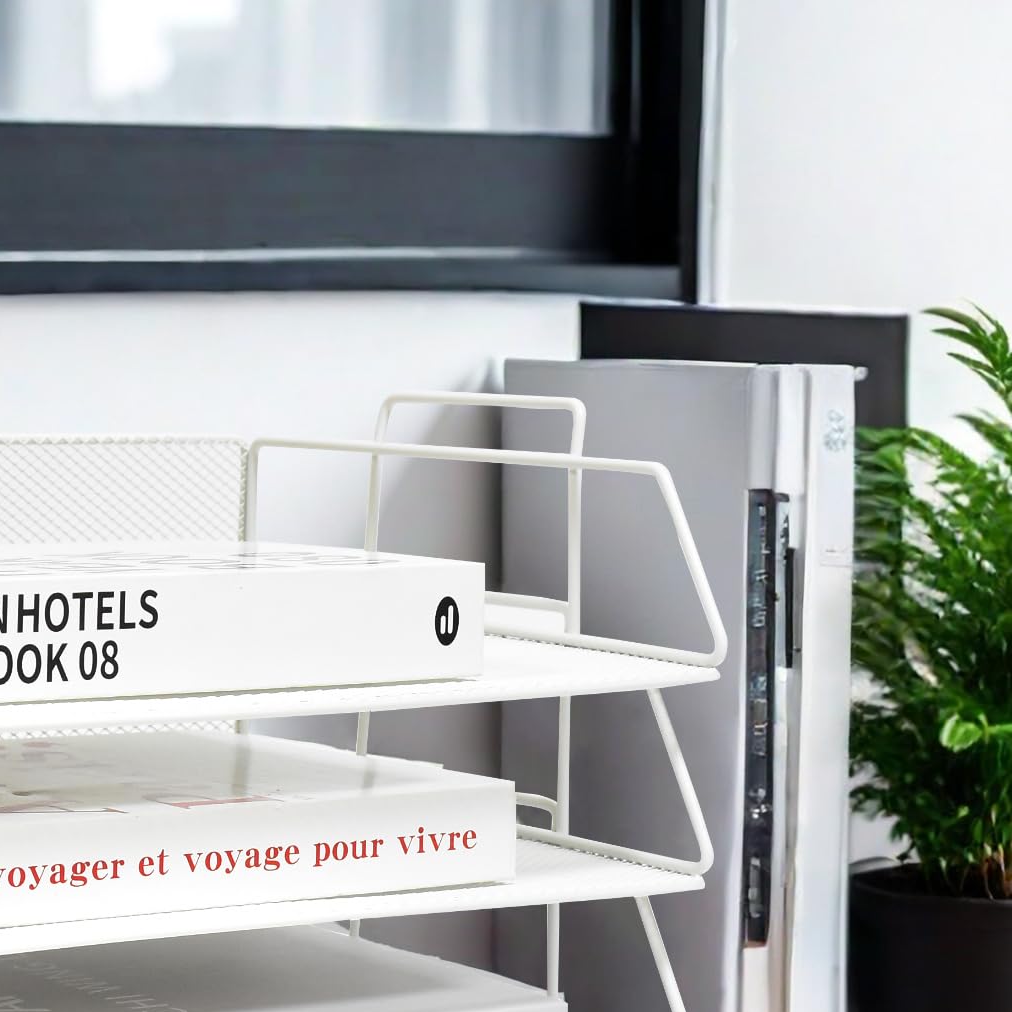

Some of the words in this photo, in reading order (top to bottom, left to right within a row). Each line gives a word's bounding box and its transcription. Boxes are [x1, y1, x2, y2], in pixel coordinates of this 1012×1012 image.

[17, 589, 159, 634] HOTELS
[79, 639, 119, 681] 08
[137, 851, 168, 877] et
[184, 847, 300, 874] voyage
[313, 838, 384, 867] pour
[397, 826, 478, 854] vivre
